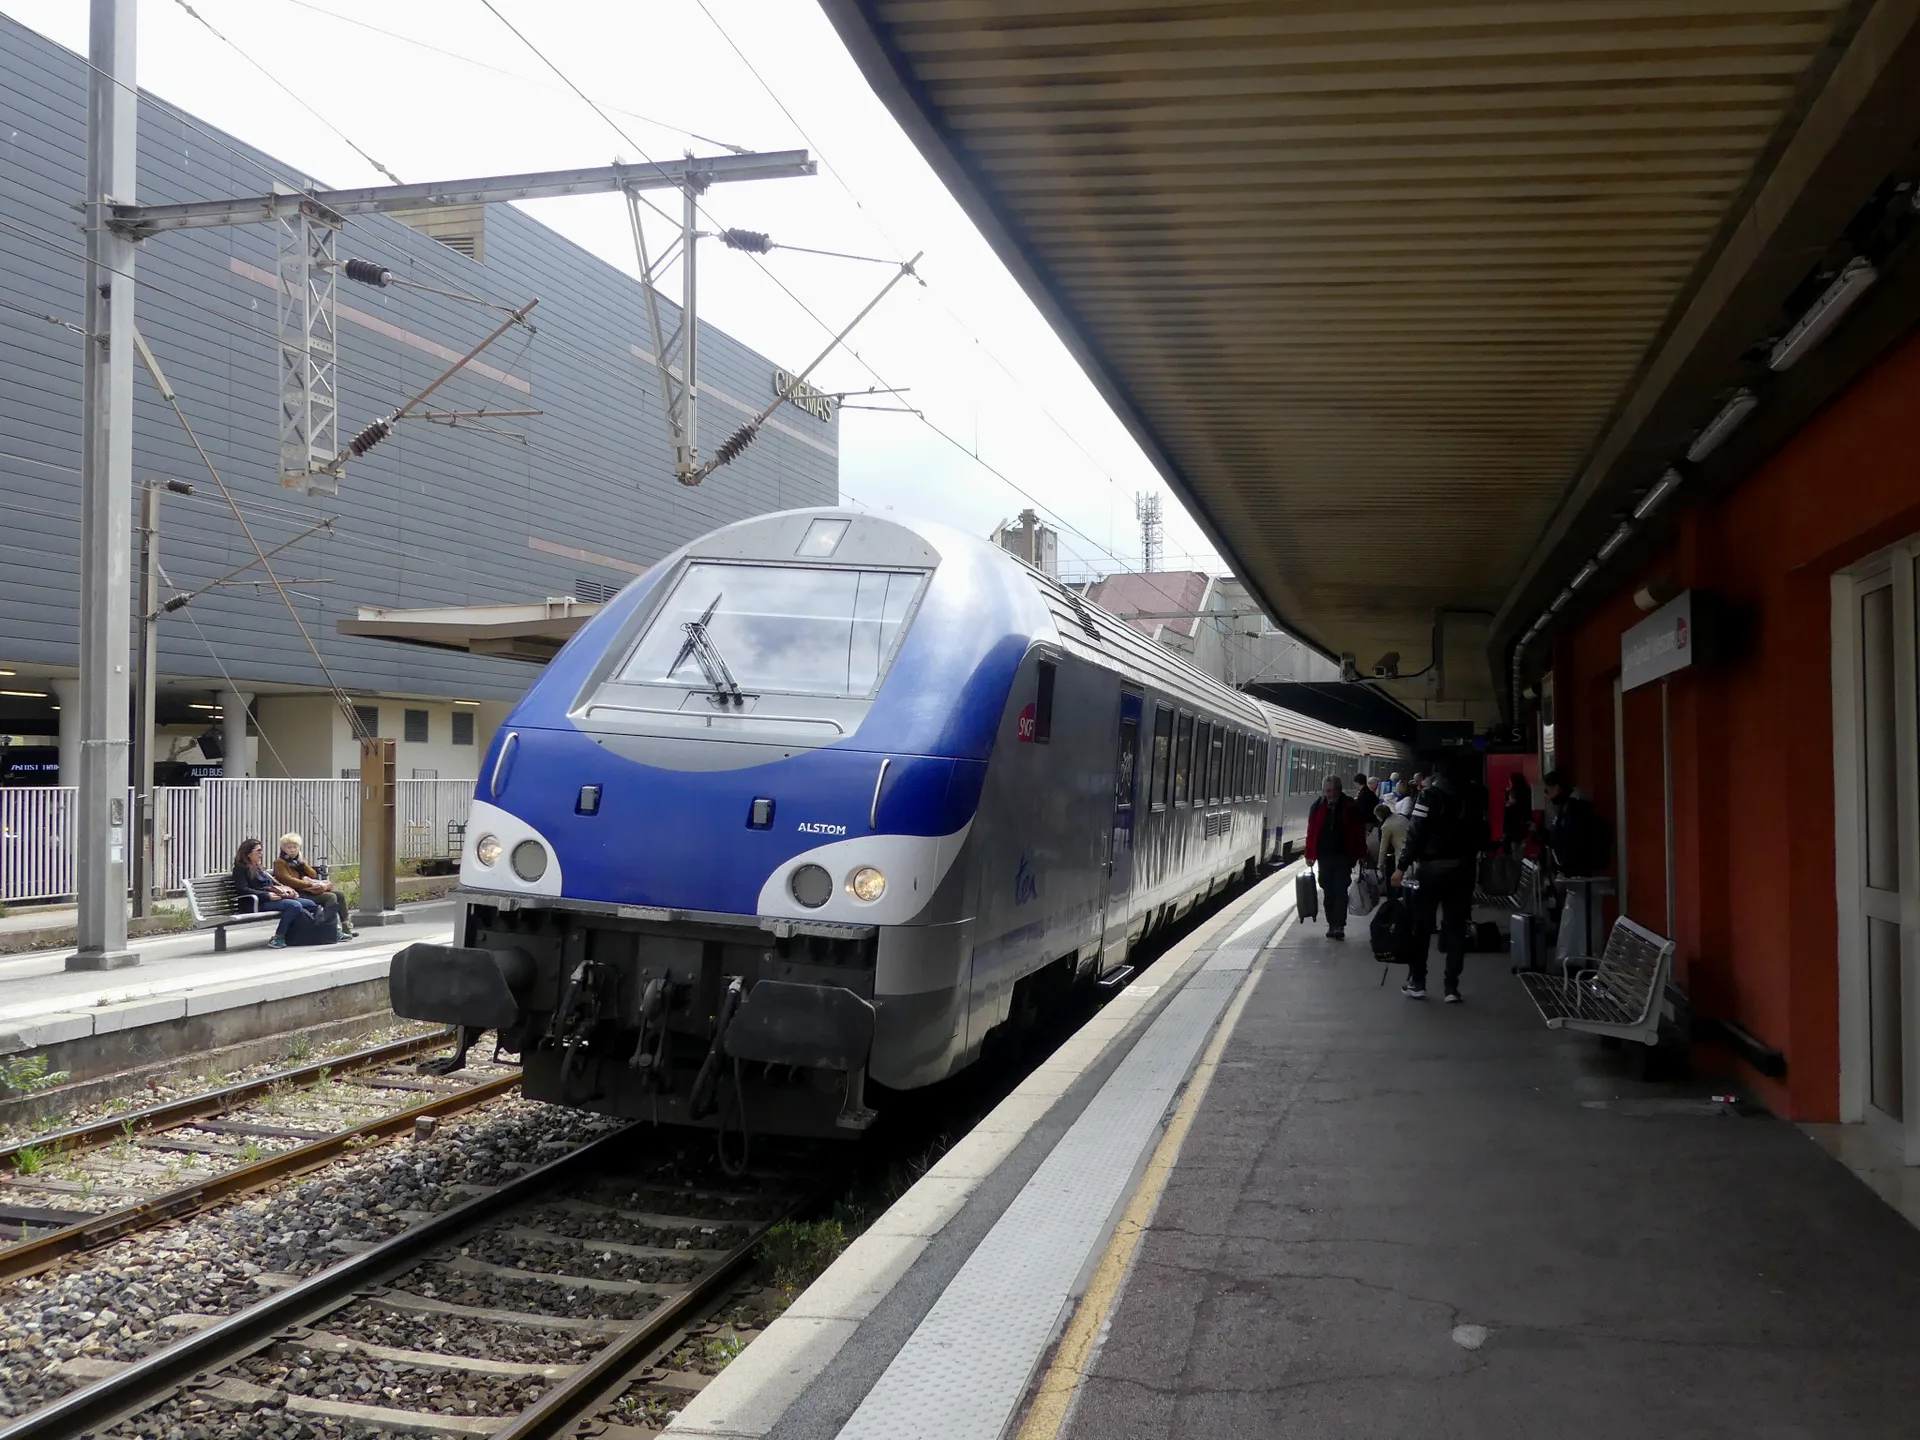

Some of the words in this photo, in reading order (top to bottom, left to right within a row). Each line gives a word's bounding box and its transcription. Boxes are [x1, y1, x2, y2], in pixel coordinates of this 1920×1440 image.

[774, 369, 832, 423] CINEMAS
[1018, 717, 1034, 737] SNCF
[191, 767, 208, 777] ALLO
[209, 767, 223, 777] BUS
[797, 822, 847, 835] ALSTOM
